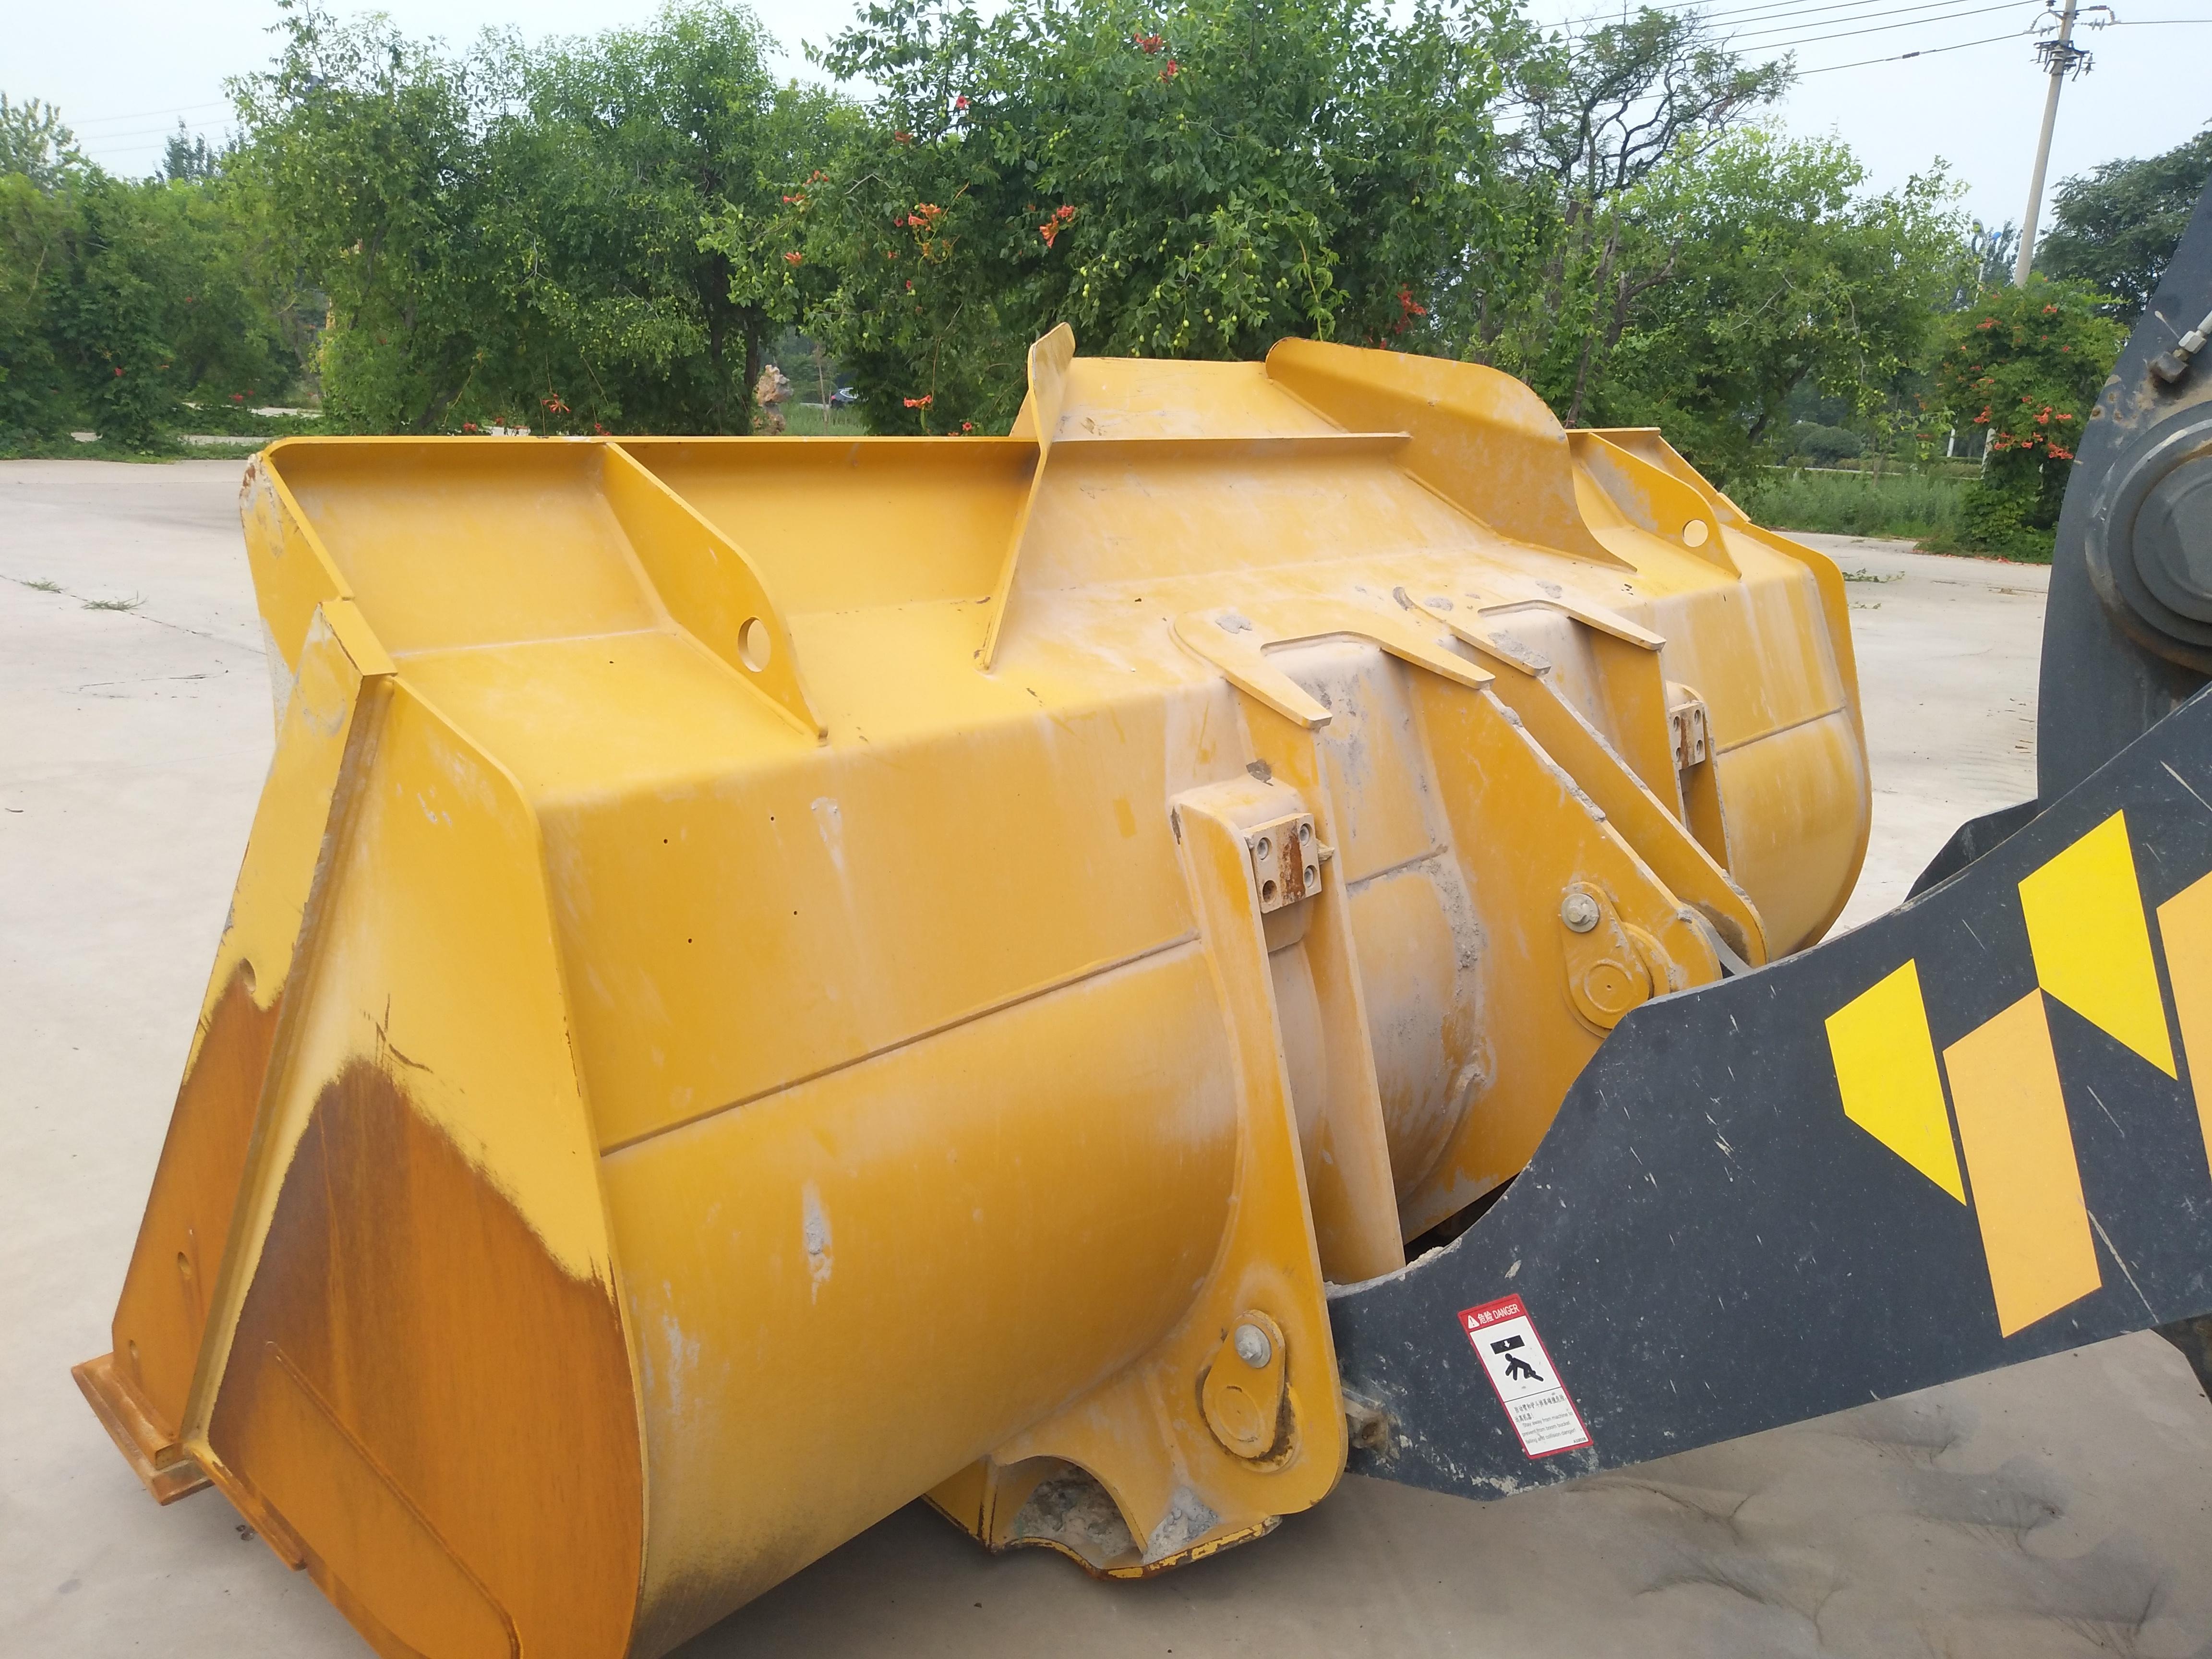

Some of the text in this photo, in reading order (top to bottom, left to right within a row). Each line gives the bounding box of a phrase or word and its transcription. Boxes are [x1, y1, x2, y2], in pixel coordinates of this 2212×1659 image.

[1478, 1304, 1520, 1324] 危险 DANGER
[1522, 1429, 1536, 1437] prevent
